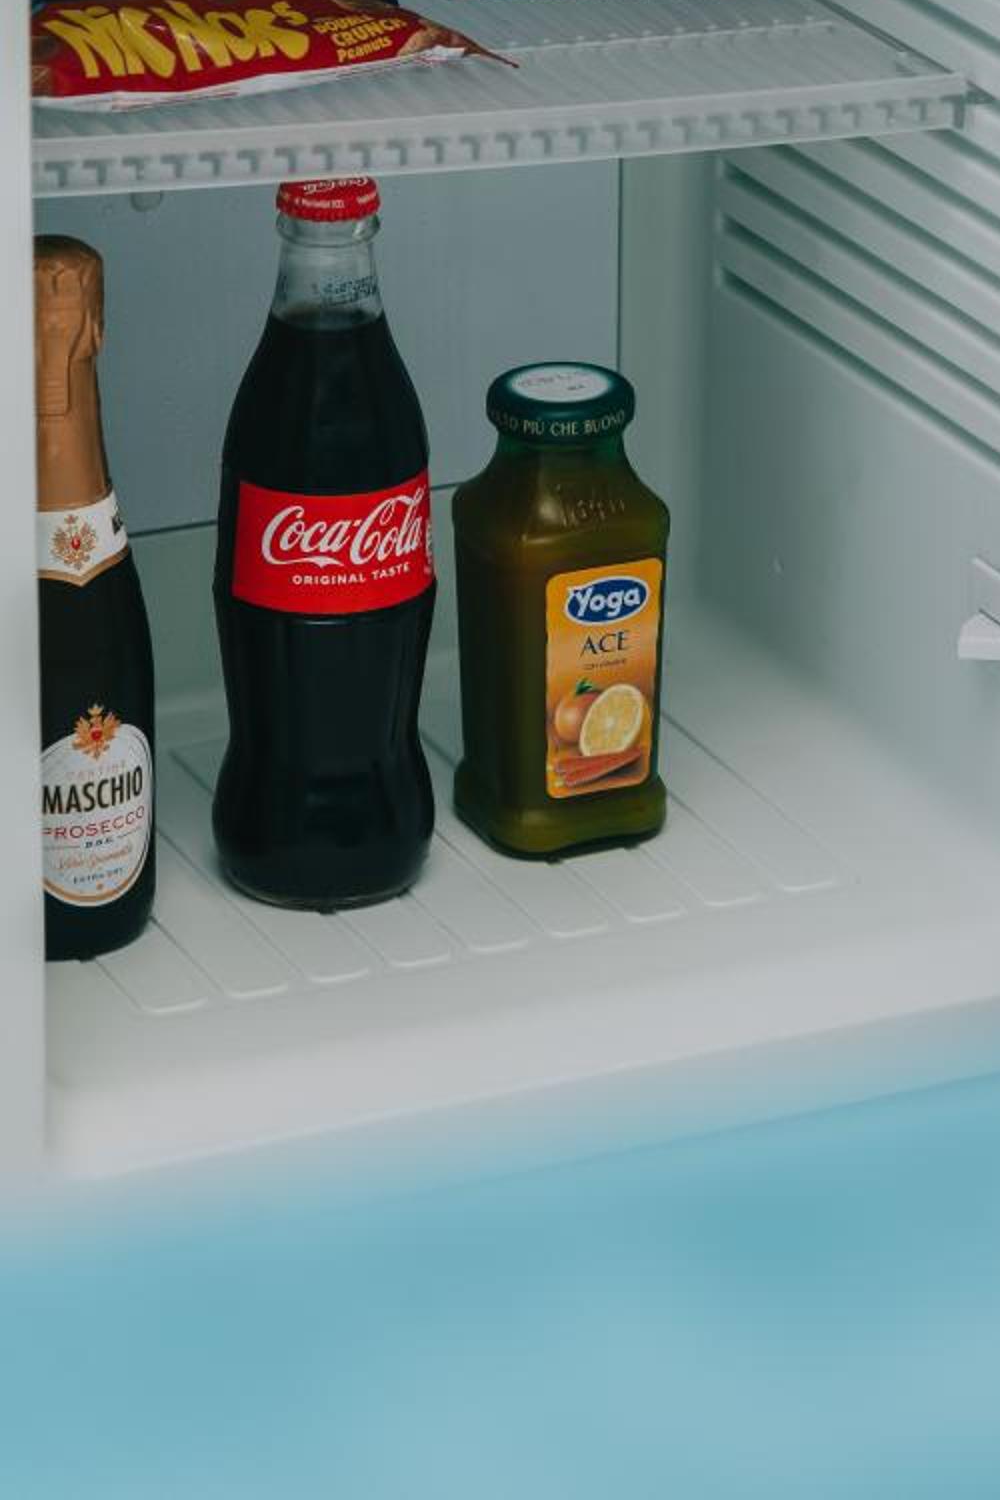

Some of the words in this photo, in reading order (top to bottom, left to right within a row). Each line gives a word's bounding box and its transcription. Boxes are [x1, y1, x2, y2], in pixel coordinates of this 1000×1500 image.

[550, 421, 580, 437] CHE
[261, 484, 426, 568] Coca-Cola
[292, 572, 366, 586] ORIGINAL
[371, 561, 410, 581] TASTE
[570, 584, 642, 618] Yoga
[580, 630, 630, 657] ACE
[42, 764, 144, 815] MASCHIO
